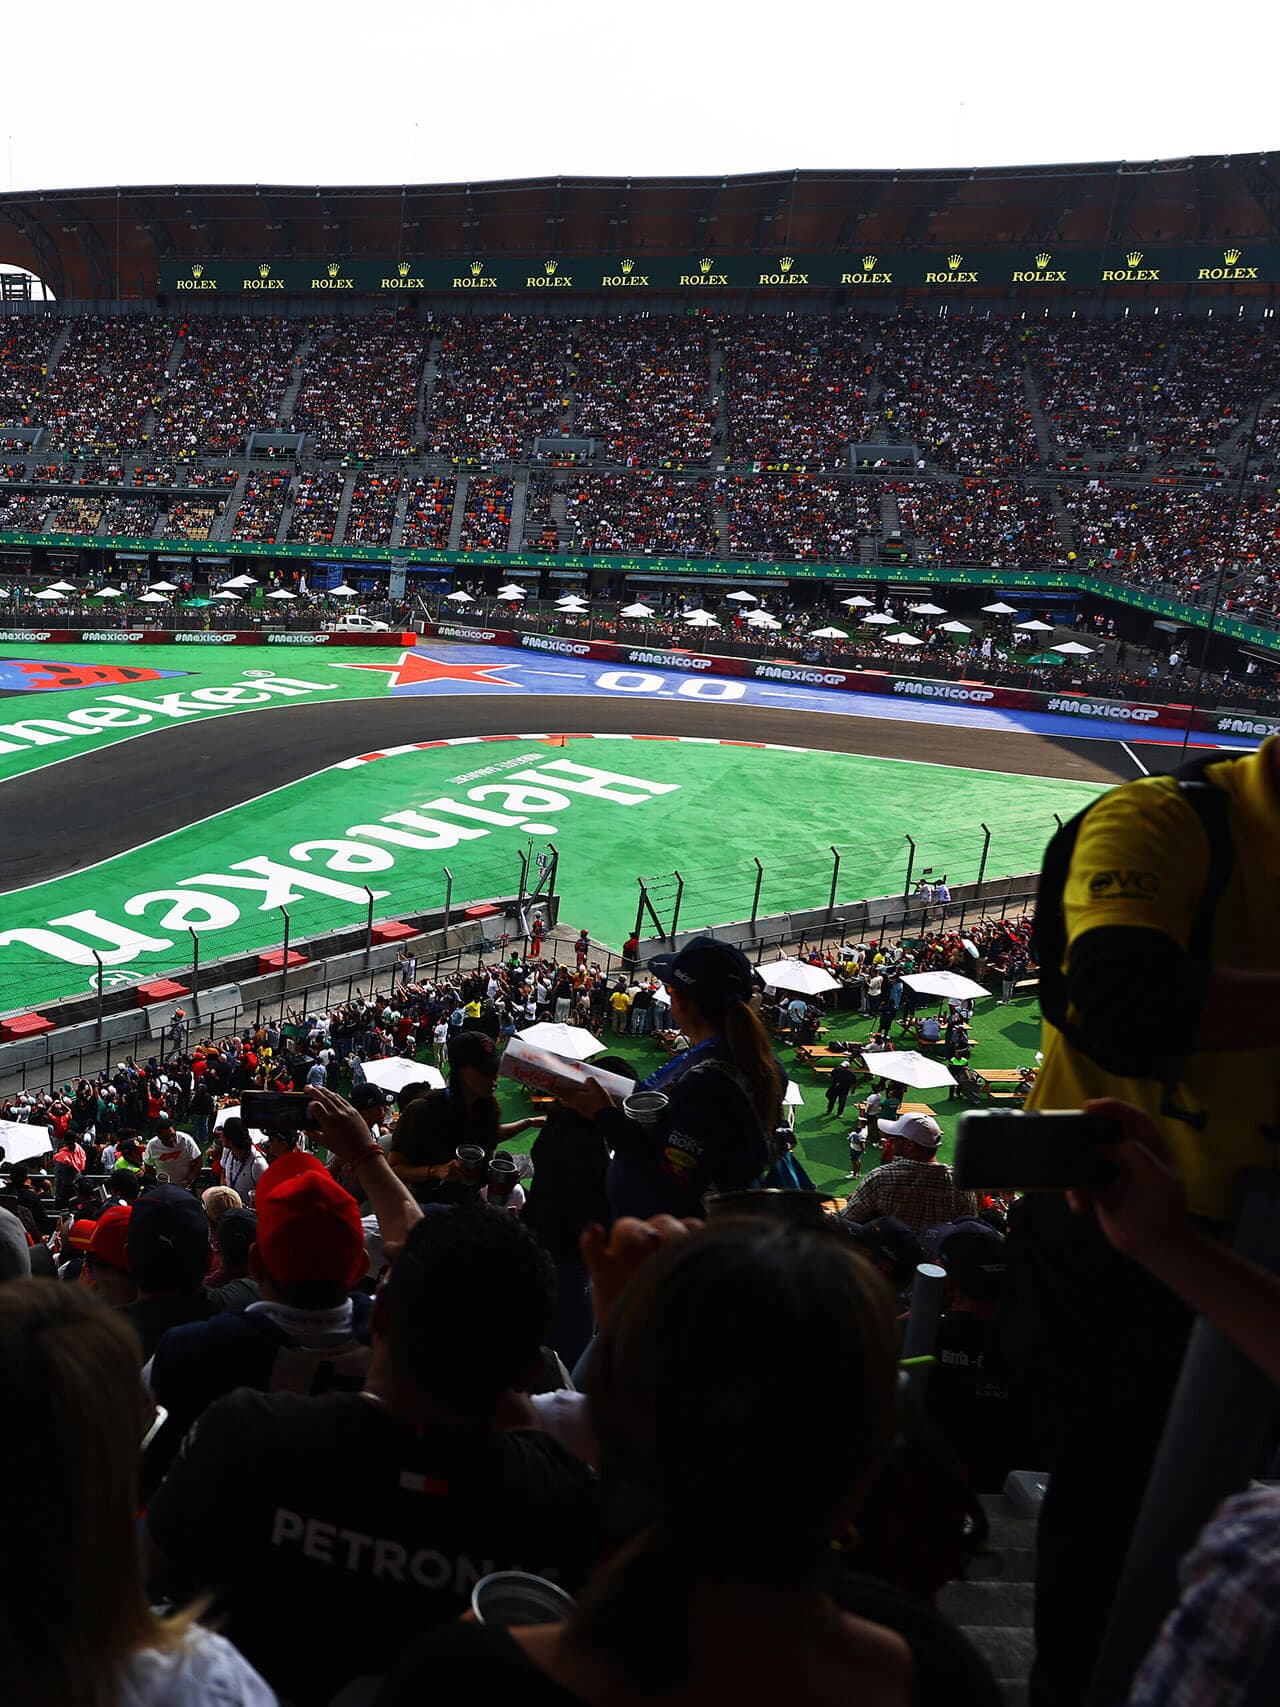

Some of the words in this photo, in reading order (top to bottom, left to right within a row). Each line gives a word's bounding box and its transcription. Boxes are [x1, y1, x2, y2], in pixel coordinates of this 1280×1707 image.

[759, 274, 808, 284] ROLEX
[841, 273, 891, 284] ROLEX
[926, 272, 977, 283] ROLEX
[1013, 271, 1066, 282] ROLEX
[1103, 269, 1159, 281] ROLEX
[1198, 267, 1257, 280] ROLEX
[177, 280, 216, 289] ROLEX
[243, 279, 284, 289] ROLEX
[311, 279, 353, 289] ROLEX
[381, 278, 423, 288] ROLEX
[453, 277, 496, 288] ROLEX
[527, 277, 571, 287] ROLEX
[602, 276, 648, 286] ROLEX
[680, 275, 727, 285] ROLEX
[82, 632, 144, 641] #MexicoGP
[175, 633, 236, 643] #MexicoGP
[268, 634, 329, 643] #MexicoGP
[438, 627, 496, 641] #MexicoGP
[522, 635, 591, 655] #MexicoGP
[629, 651, 712, 670] #MexicoGP
[755, 665, 847, 685] #MexicoGP
[595, 671, 747, 701] 0.0
[893, 681, 995, 702] #MexicoGP
[1048, 698, 1160, 722] #MexicoGP
[1217, 718, 1280, 736] #Mex
[271, 1505, 561, 1595] PETRON
